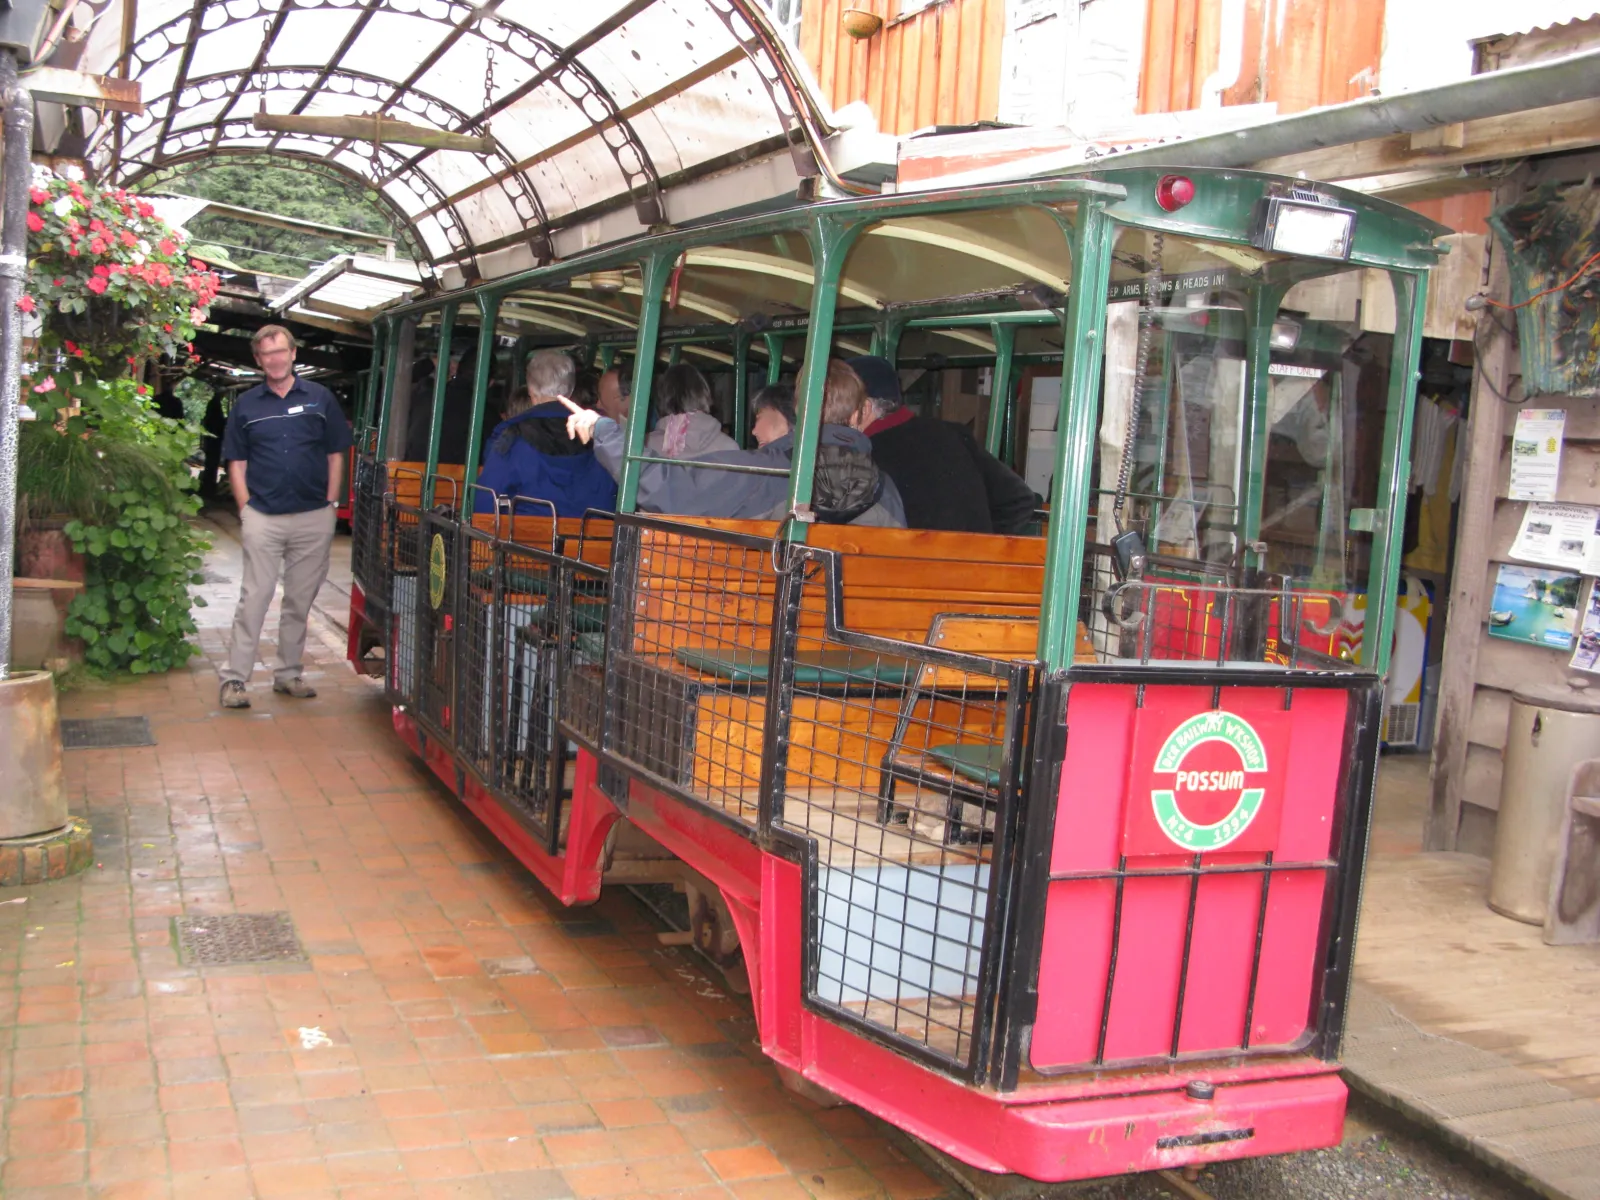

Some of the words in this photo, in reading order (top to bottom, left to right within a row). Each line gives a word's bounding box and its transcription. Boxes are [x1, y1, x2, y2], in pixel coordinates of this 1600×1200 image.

[1174, 281, 1180, 290] &
[1182, 276, 1209, 289] HEADS
[1212, 274, 1225, 286] IN!
[1270, 363, 1293, 375] STAFF
[1175, 717, 1225, 747] RAILWAY
[1175, 770, 1245, 791] POSSUM
[1213, 808, 1249, 843] 1994
